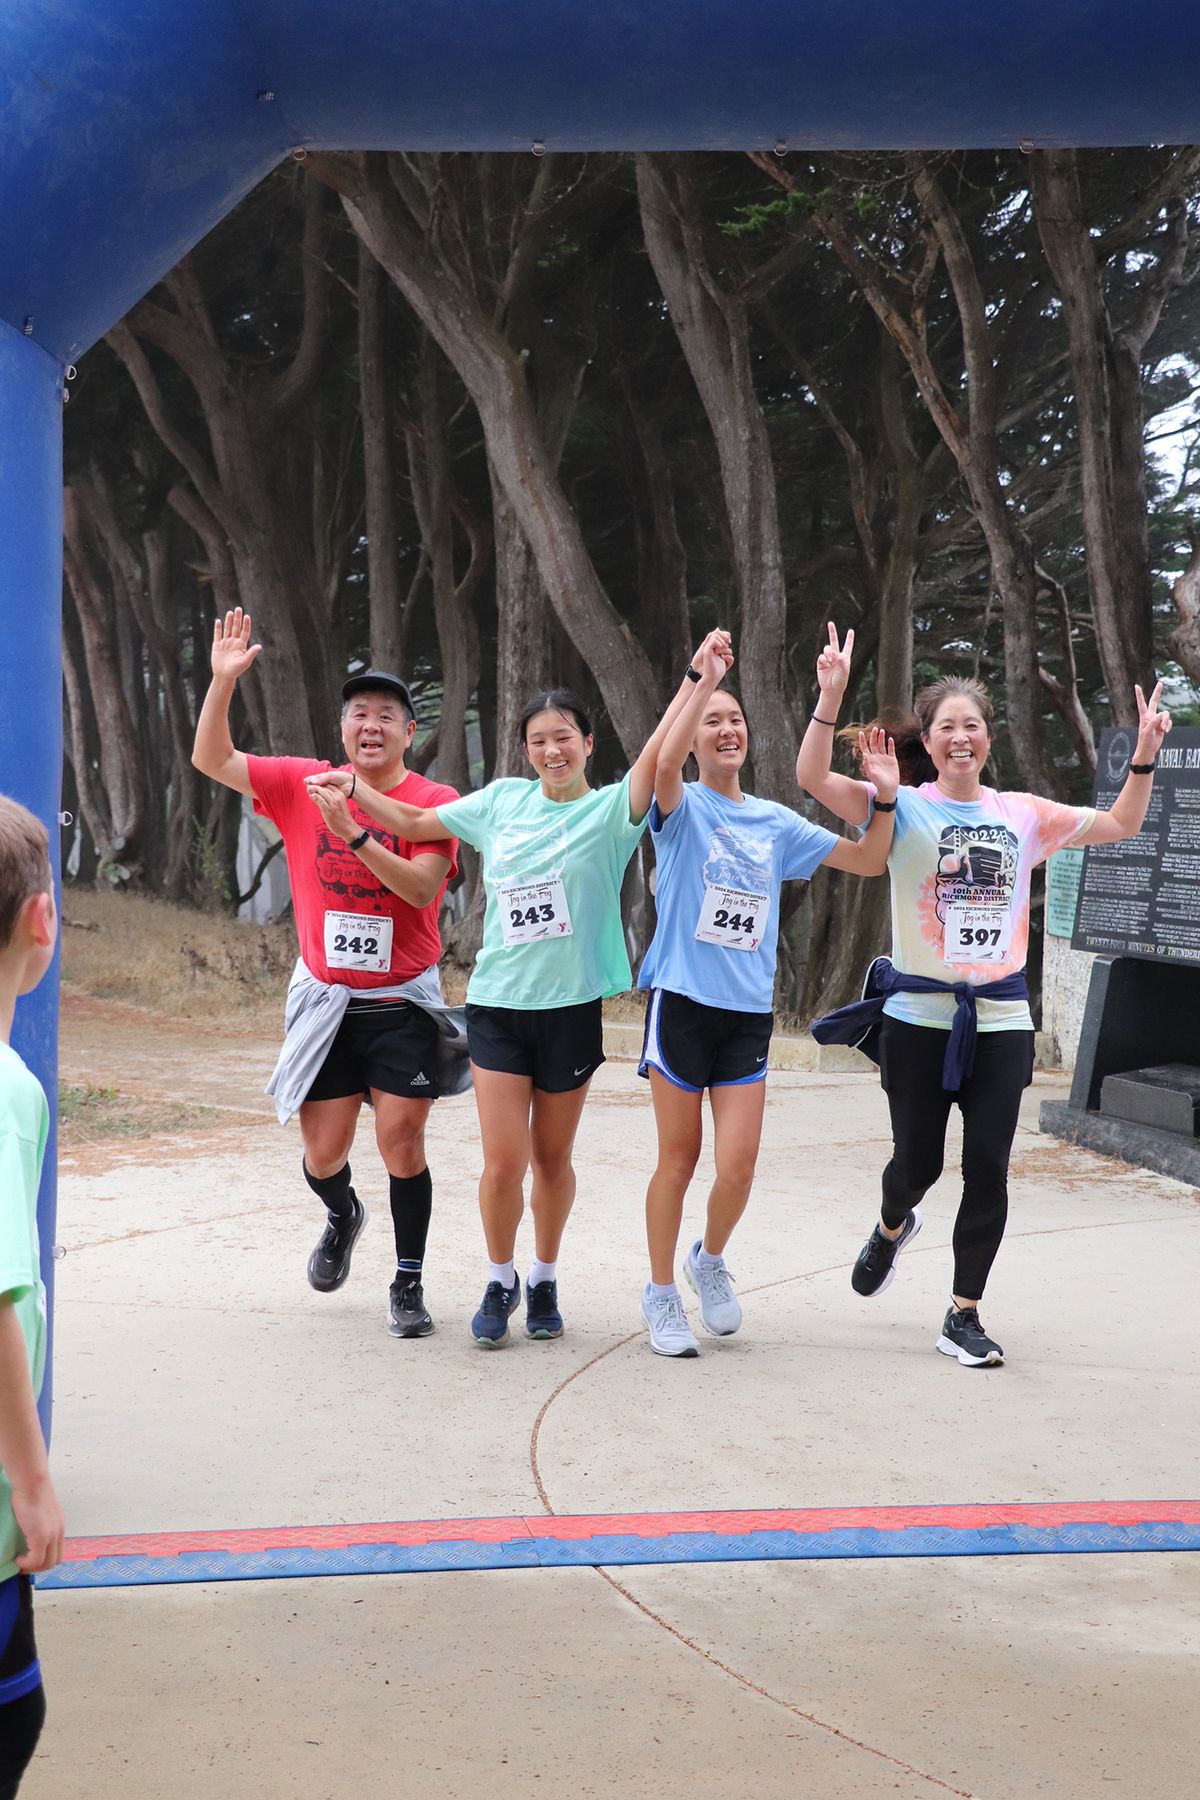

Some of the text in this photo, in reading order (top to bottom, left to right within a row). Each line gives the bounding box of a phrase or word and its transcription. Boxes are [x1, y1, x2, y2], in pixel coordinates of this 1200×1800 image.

[1157, 748, 1184, 769] NAVAL
[964, 828, 1000, 841] 022
[536, 880, 557, 888] DISTRICT
[508, 893, 520, 907] Jog
[527, 891, 537, 900] the
[536, 887, 552, 901] Fog
[718, 894, 733, 908] Jog
[749, 900, 760, 914] Fog
[942, 893, 982, 902] RICHMOND
[510, 904, 556, 928] 243
[713, 910, 754, 934] 244
[960, 912, 974, 926] Jog
[982, 913, 990, 921] the
[990, 912, 1002, 926] Fog
[336, 918, 348, 933] Jog
[357, 922, 366, 930] the
[367, 922, 381, 936] Fog
[334, 934, 378, 955] 242
[960, 928, 1001, 946] 397
[1128, 942, 1155, 953] MINUTES
[1156, 945, 1166, 954] OF
